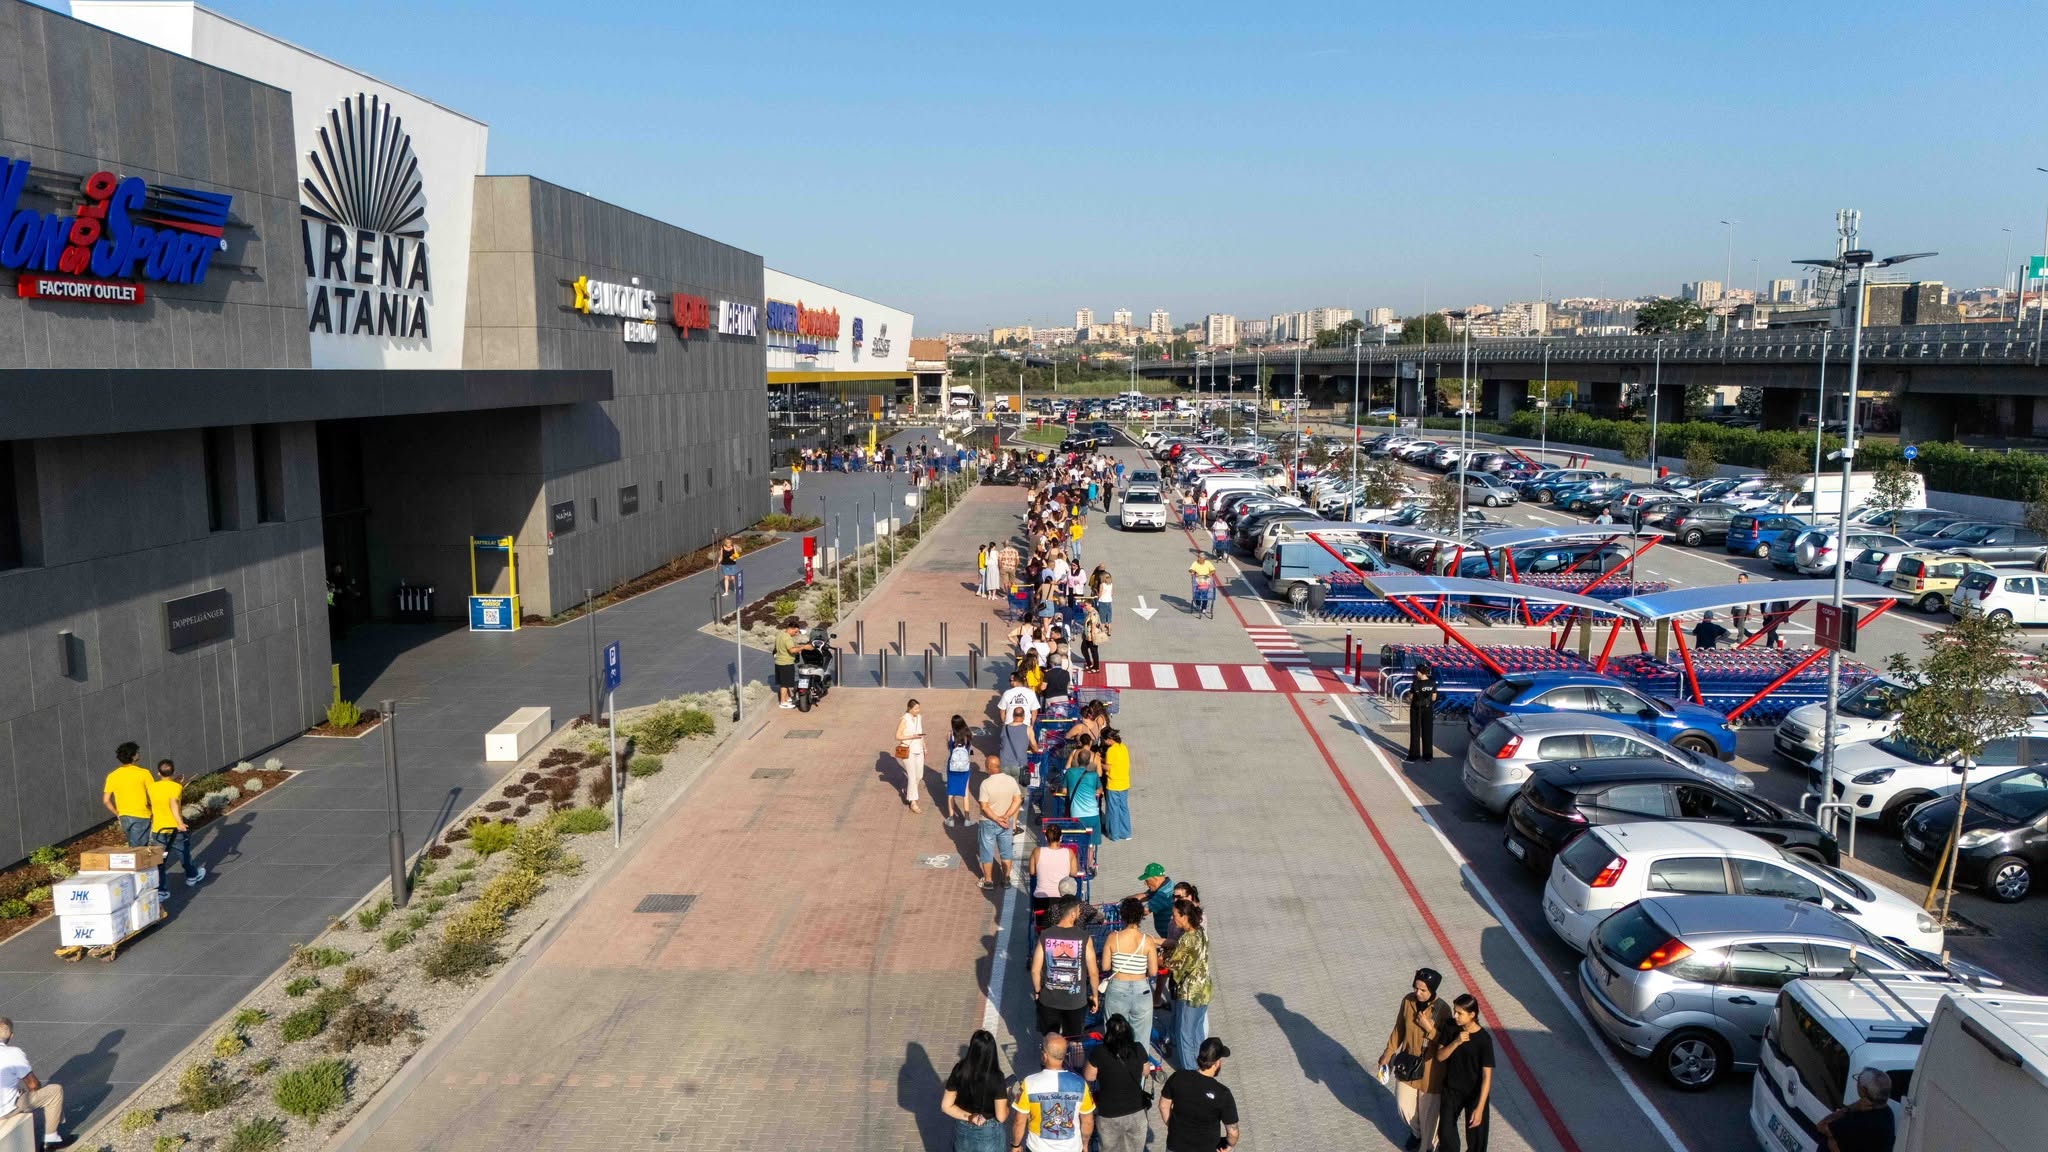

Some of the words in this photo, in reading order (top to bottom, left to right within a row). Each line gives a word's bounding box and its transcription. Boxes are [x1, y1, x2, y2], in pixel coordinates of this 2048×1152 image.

[39, 279, 93, 298] FACTORY
[94, 284, 136, 301] OUTLET
[587, 277, 657, 321] euronics
[307, 285, 428, 338] ATANIA
[1825, 617, 1830, 635] 1
[70, 890, 89, 901] JHK
[73, 928, 95, 939] JHK
